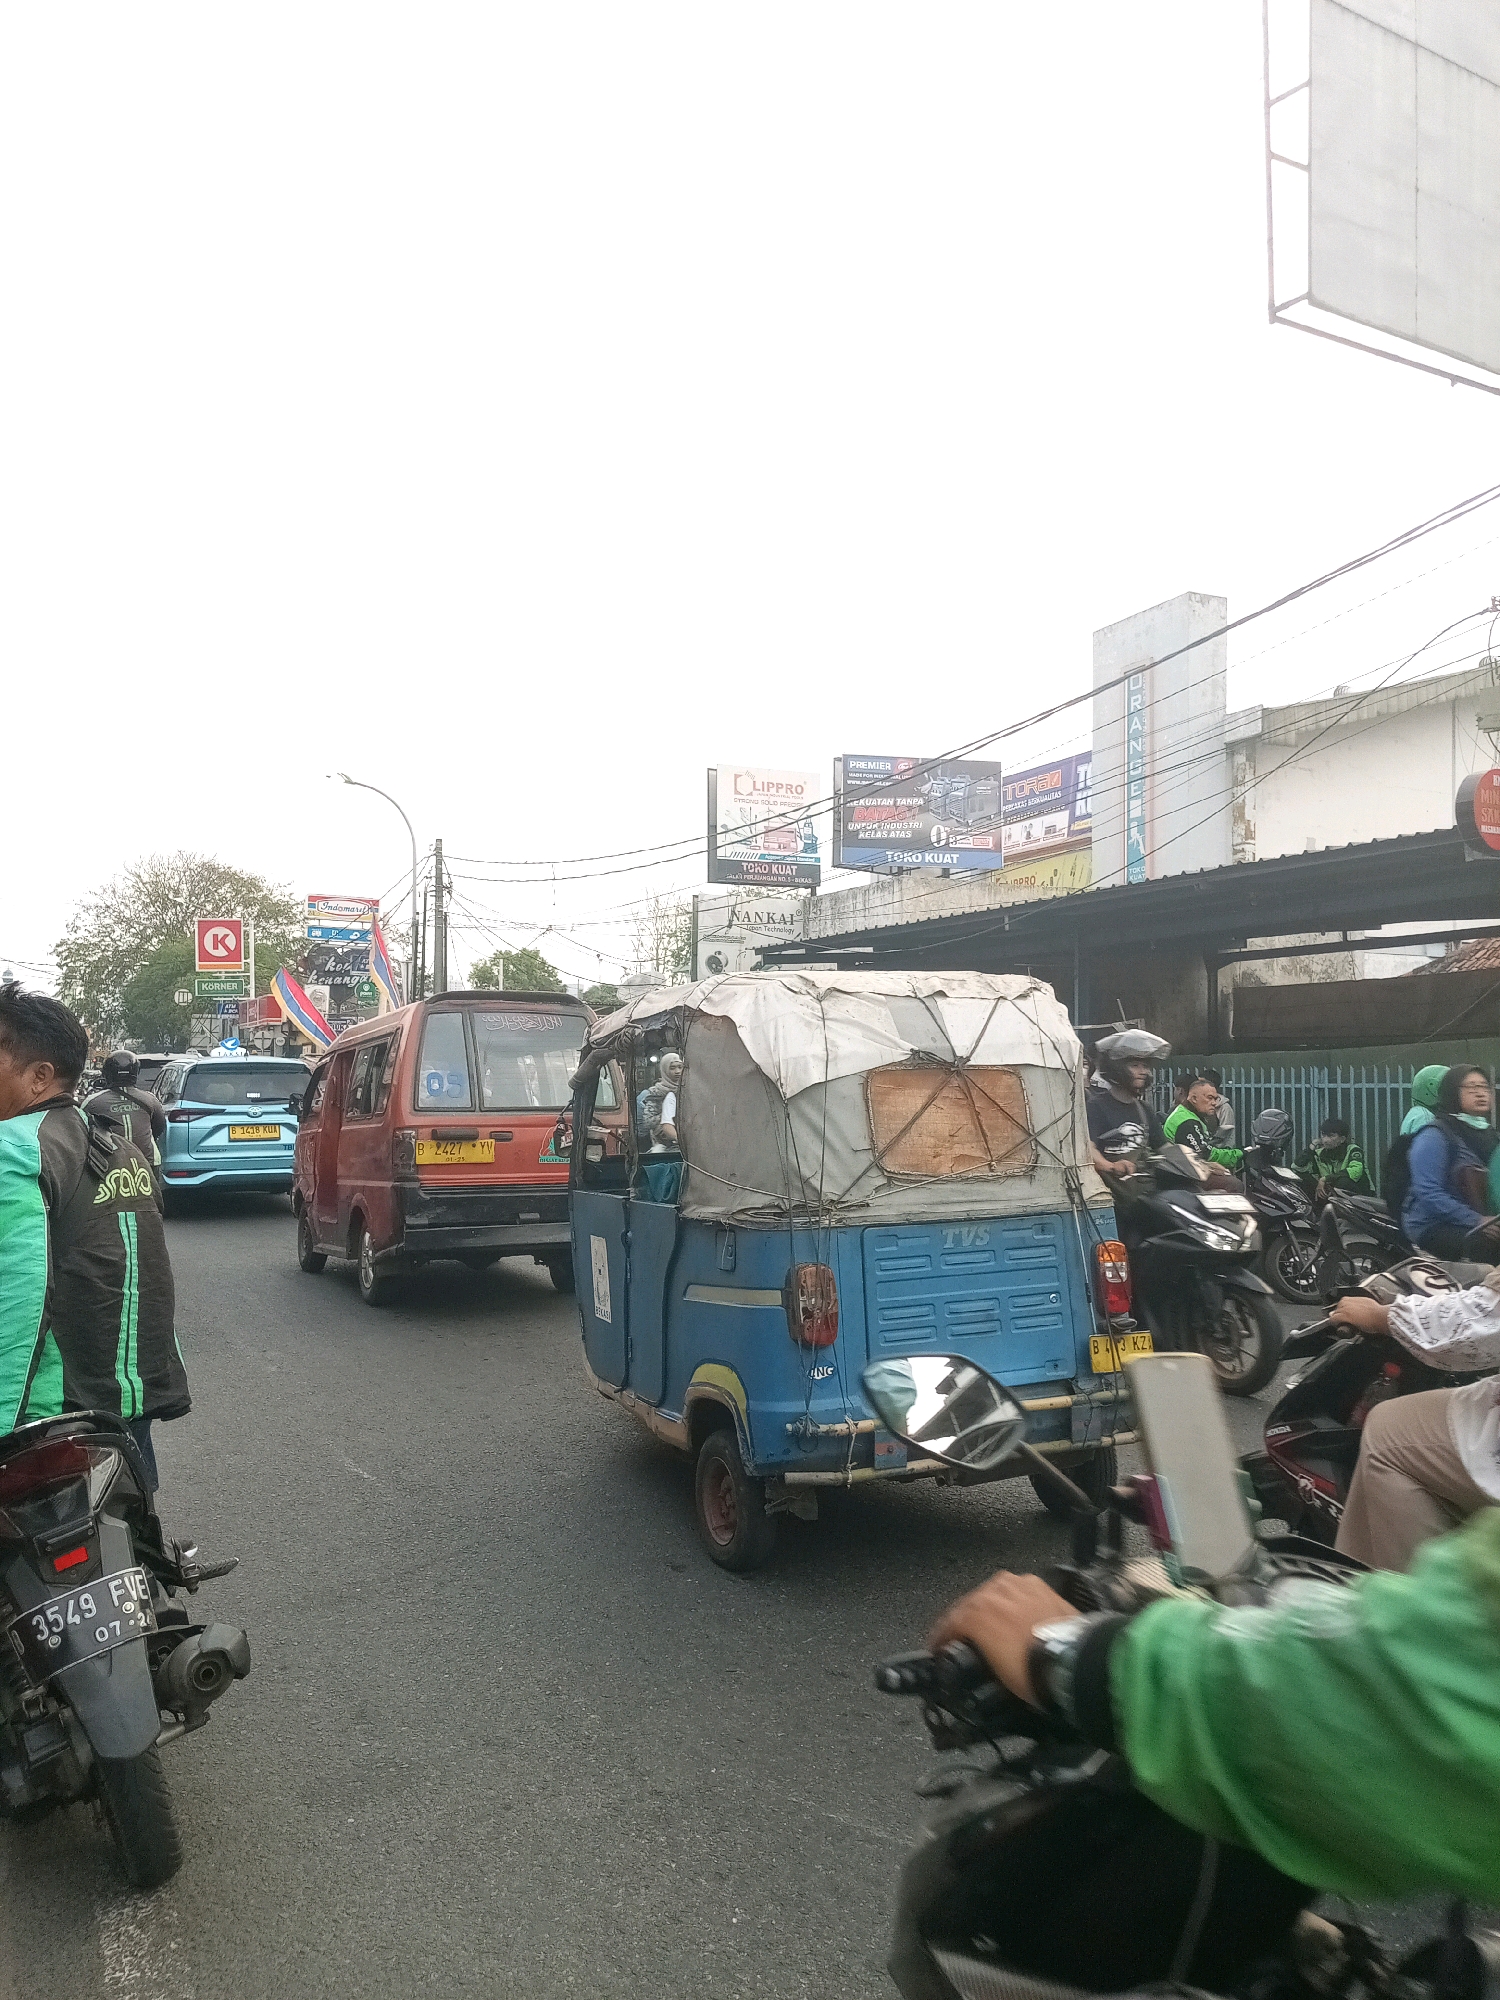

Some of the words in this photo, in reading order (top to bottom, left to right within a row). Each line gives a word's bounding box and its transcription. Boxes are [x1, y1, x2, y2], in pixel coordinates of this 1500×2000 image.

[849, 760, 891, 770] PREMIER
[894, 797, 924, 805] TANPA
[881, 822, 923, 830] INDUSTRI
[886, 851, 922, 863] TOKO
[925, 852, 960, 864] KUAT
[741, 862, 770, 873] TOKO
[772, 864, 798, 876] KUAT
[732, 910, 795, 925] NANKAI
[764, 925, 795, 935] Technology
[231, 1126, 237, 1135] B
[417, 1142, 425, 1156] B
[435, 1141, 463, 1156] 2427
[941, 1224, 991, 1250] TVS
[1092, 1340, 1100, 1355] B
[31, 1592, 97, 1641] 3549
[107, 1574, 149, 1607] FVE
[95, 1620, 121, 1642] 07
